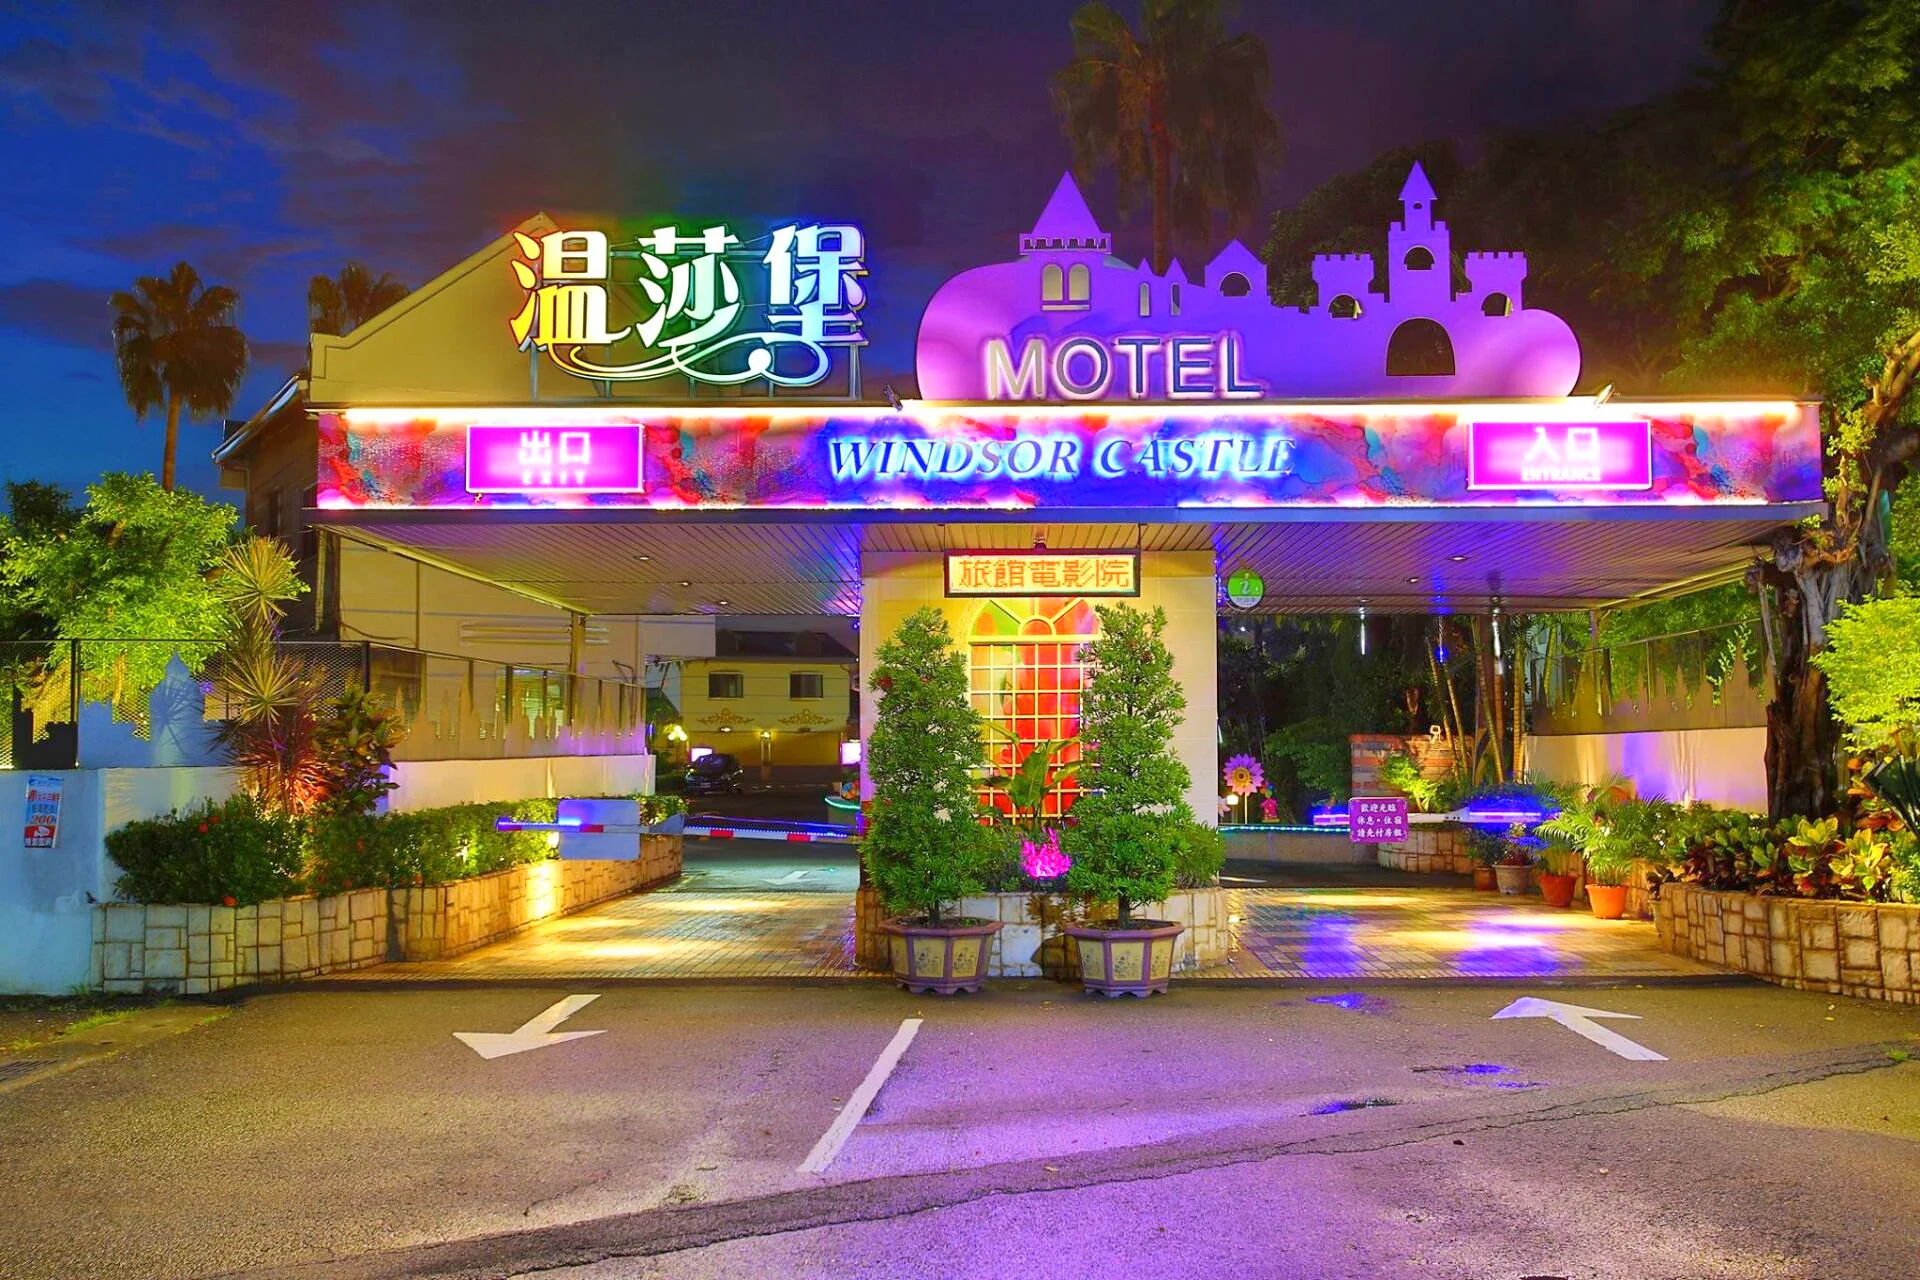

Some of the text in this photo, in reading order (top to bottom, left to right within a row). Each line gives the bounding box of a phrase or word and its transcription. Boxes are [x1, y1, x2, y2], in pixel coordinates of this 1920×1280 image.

[985, 333, 1266, 400] MOTEL
[517, 430, 590, 464] 出口
[829, 437, 1297, 476] WINDSOR CASTLE
[1523, 426, 1600, 461] 入口
[521, 469, 586, 485] EXIT
[958, 557, 1131, 589] 旅館電影院
